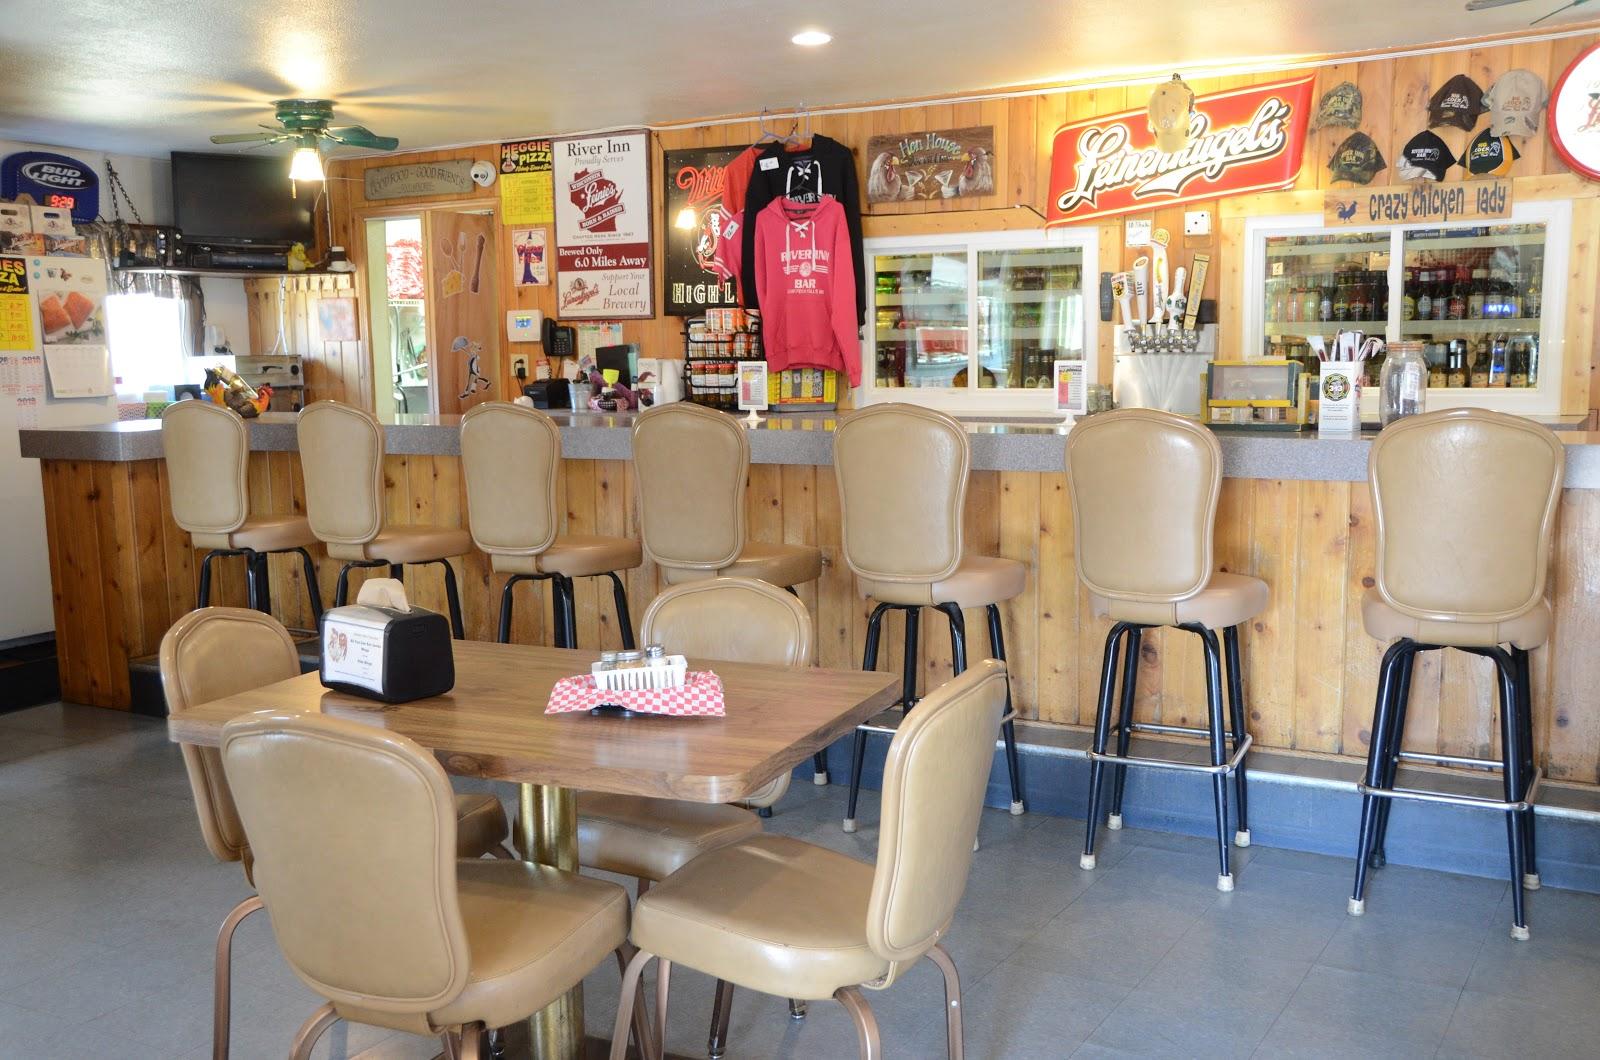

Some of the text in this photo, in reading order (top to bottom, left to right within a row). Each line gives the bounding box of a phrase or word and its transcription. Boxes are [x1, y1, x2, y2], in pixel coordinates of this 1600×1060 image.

[501, 140, 552, 159] HEGGIE
[567, 139, 630, 156] River Inn
[899, 132, 961, 158] Hen House
[520, 152, 552, 165] PIZZA
[574, 155, 624, 165] Proudly Serves
[41, 165, 81, 177] BUD
[32, 172, 86, 186] LIGHT
[50, 194, 75, 209] 9:29
[1369, 192, 1409, 221] crazy
[1476, 181, 1507, 214] lady
[559, 246, 603, 257] Brewed Only
[575, 255, 647, 268] 6.0 Miles Away
[602, 272, 645, 284] Support Your
[794, 279, 816, 288] BAR
[608, 282, 640, 296] Local
[673, 282, 720, 304] HIGH
[603, 298, 647, 312] Brewery
